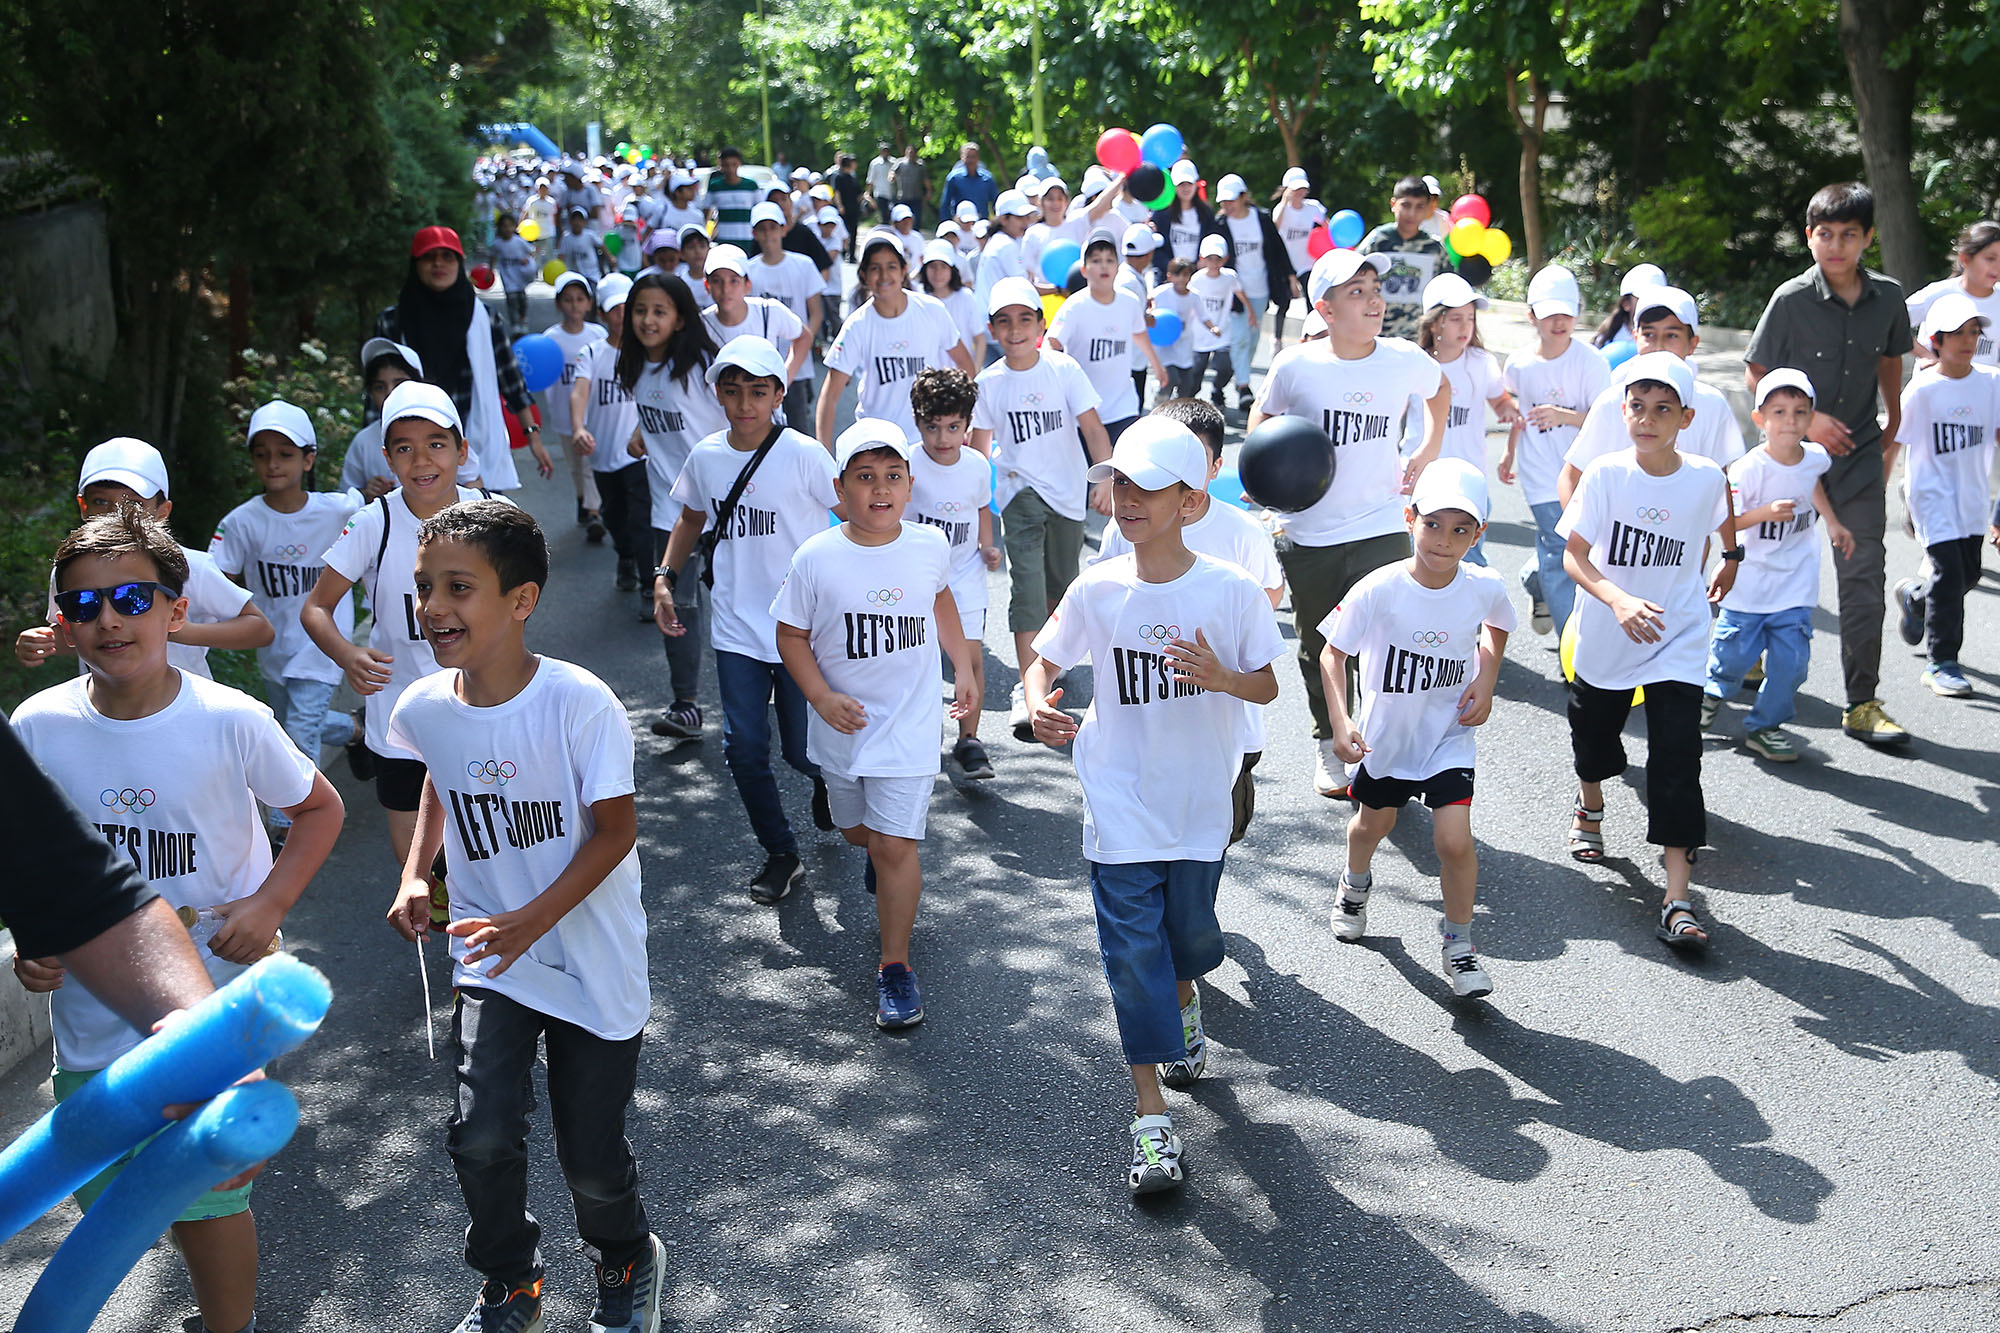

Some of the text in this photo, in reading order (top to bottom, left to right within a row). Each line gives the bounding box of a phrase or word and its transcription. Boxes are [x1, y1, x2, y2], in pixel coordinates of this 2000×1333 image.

[875, 356, 906, 385] LET'S
[636, 402, 667, 434] LET'S
[1007, 410, 1063, 444] LET'S MOVE
[1323, 408, 1390, 447] LET'S MOVE
[1932, 422, 1966, 455] LET'S
[749, 507, 777, 537] MOVE
[1607, 520, 1686, 567] LET'S MOVE
[258, 560, 325, 598] LET'S MO
[843, 612, 926, 660] LET'S MOVE
[1113, 647, 1169, 705] LET'S
[1382, 644, 1467, 694] LET'S MOVE
[448, 789, 565, 861] LET'S MOVE
[148, 828, 197, 881] MOVE
